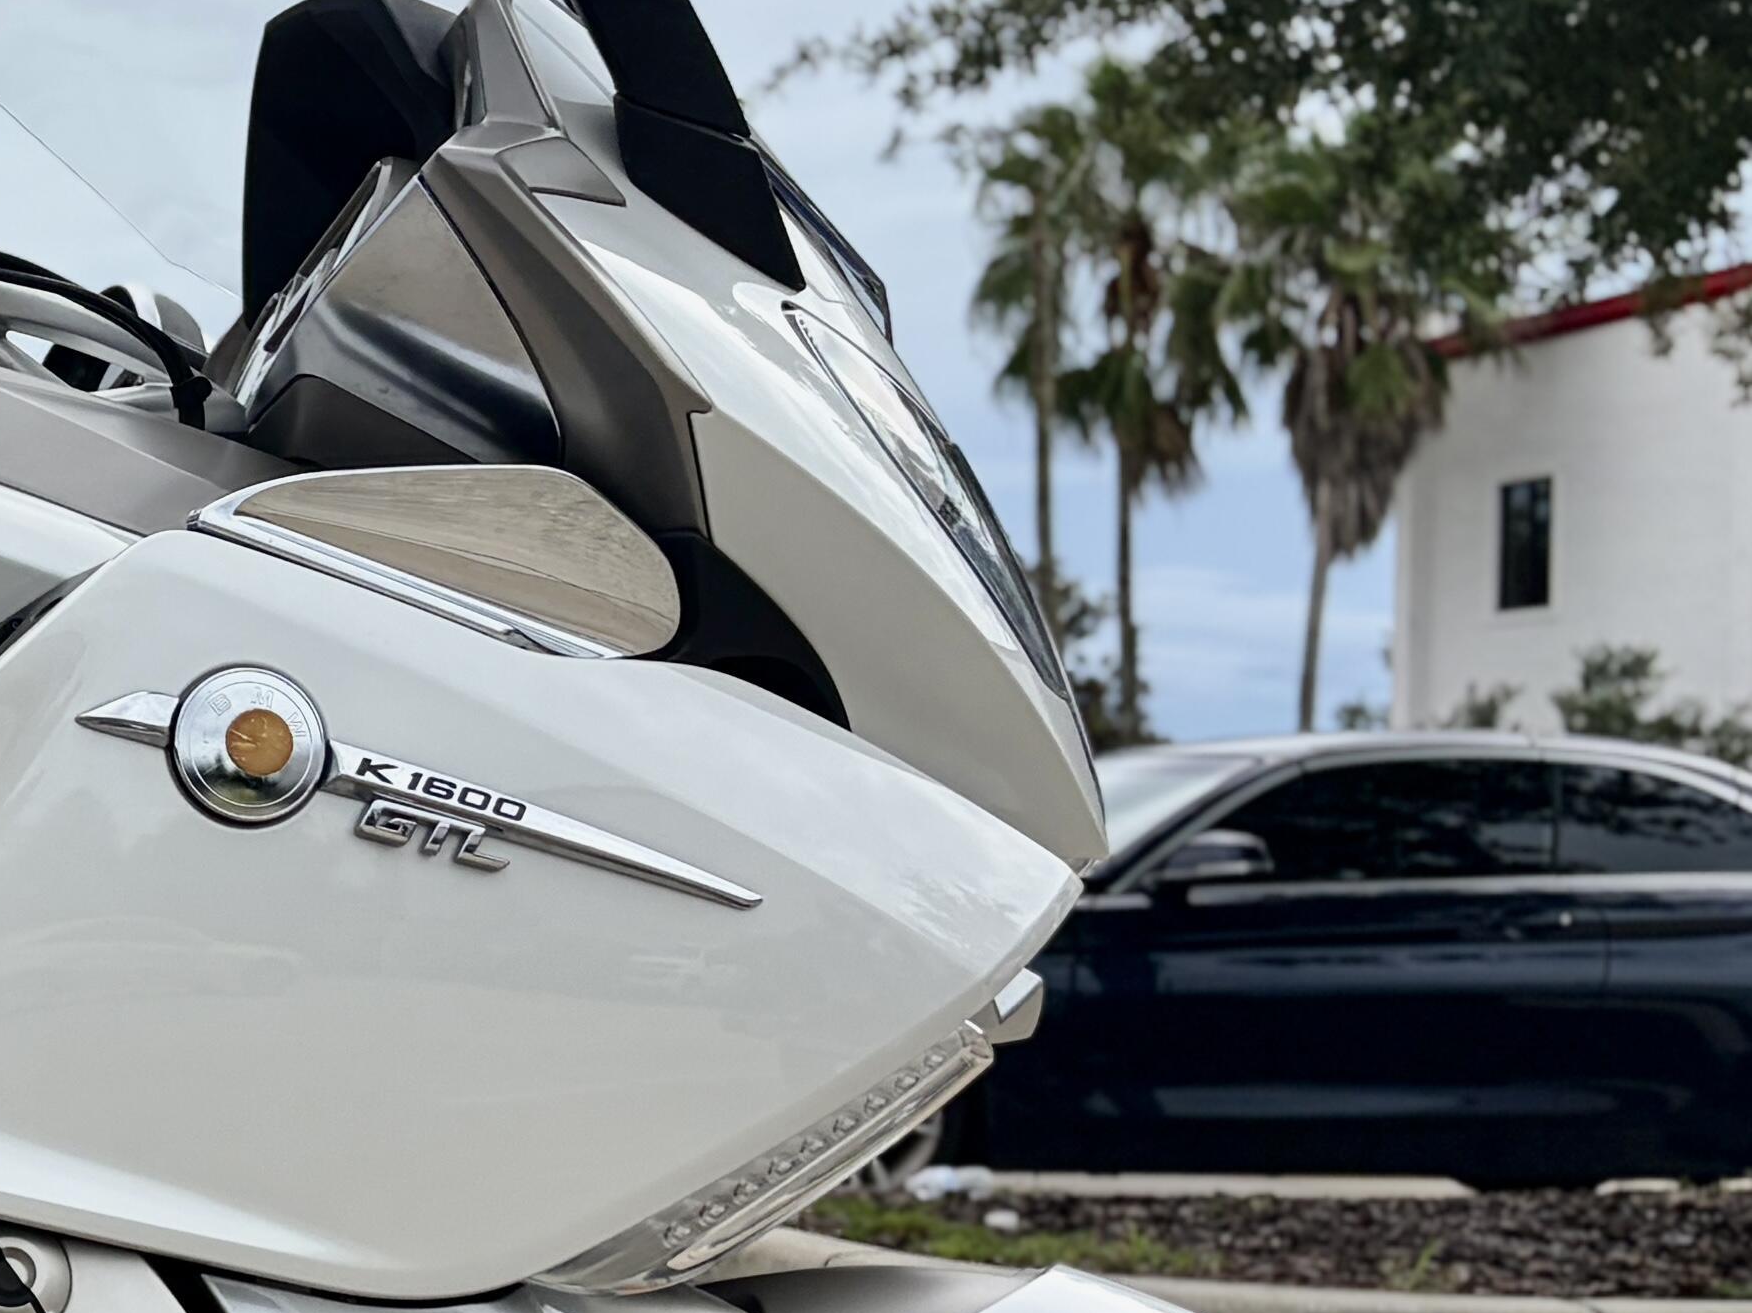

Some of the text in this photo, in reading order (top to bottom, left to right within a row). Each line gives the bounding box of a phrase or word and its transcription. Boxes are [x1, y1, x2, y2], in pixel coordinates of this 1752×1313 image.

[355, 757, 527, 822] K 1600
[355, 798, 510, 872] GTL
